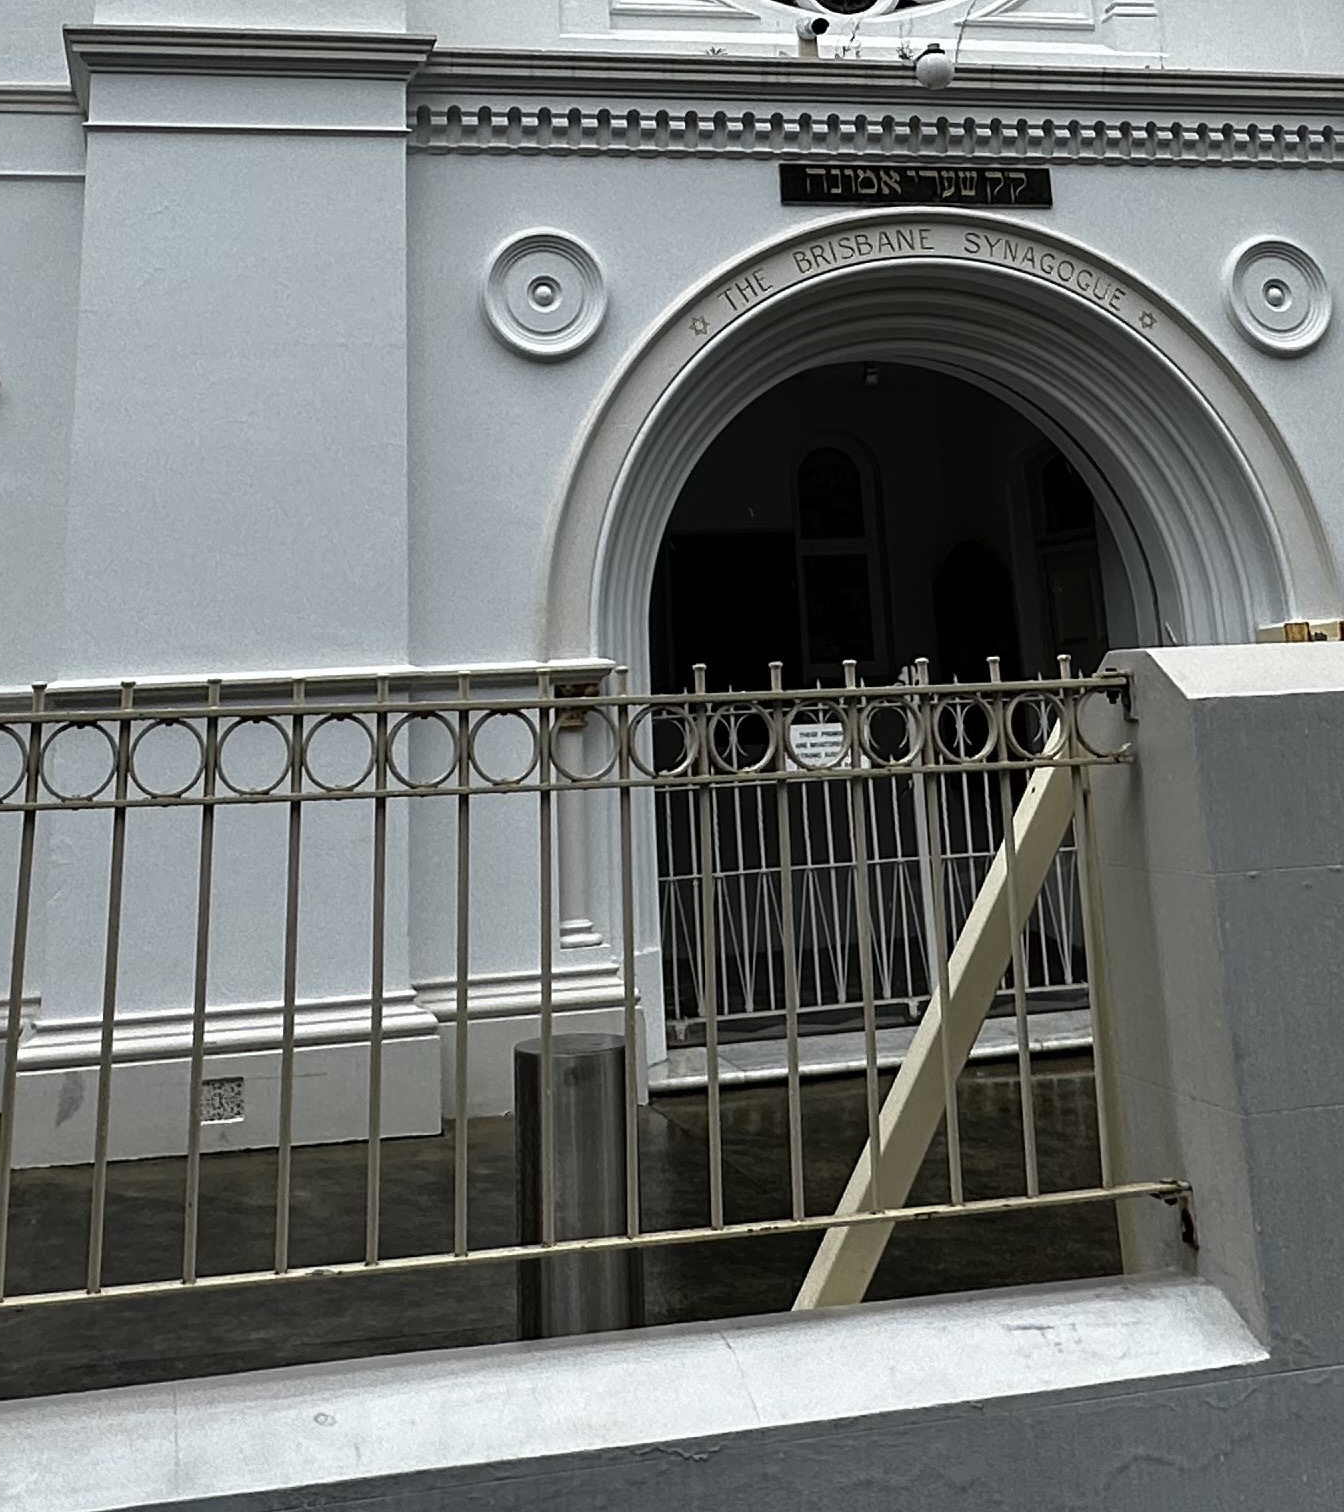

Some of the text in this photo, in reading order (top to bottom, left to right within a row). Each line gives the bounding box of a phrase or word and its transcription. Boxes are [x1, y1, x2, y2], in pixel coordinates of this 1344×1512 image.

[805, 167, 902, 195] אמונה
[906, 169, 978, 198] שערי
[717, 228, 1127, 313] THE BRISBANE SYNAGOGUE
